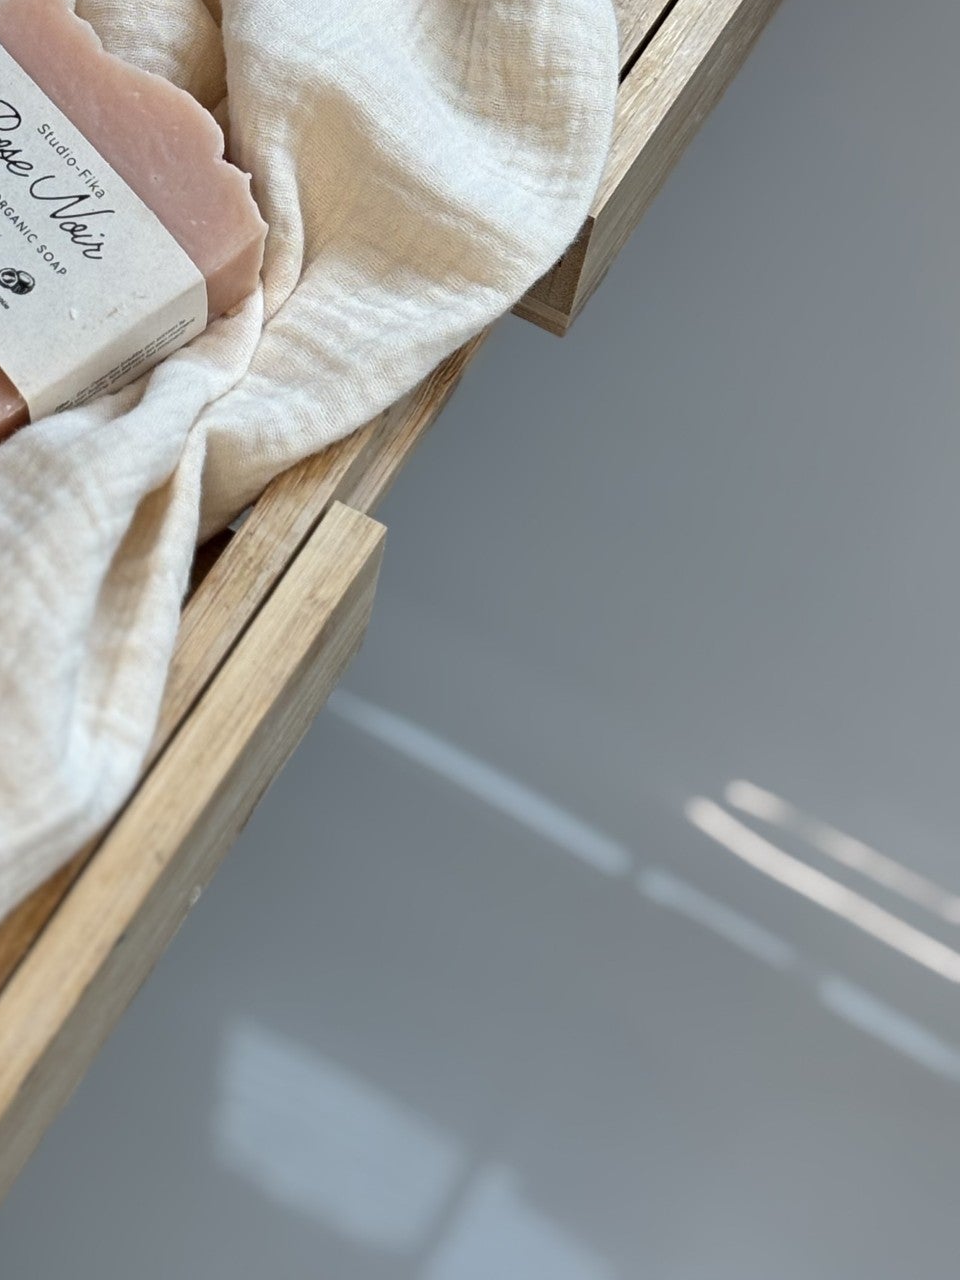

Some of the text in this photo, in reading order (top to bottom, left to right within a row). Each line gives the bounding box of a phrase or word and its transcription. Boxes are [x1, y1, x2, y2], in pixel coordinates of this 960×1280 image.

[37, 123, 106, 199] Studio-Fika
[29, 175, 115, 259] Noir
[36, 244, 67, 276] SOAP
